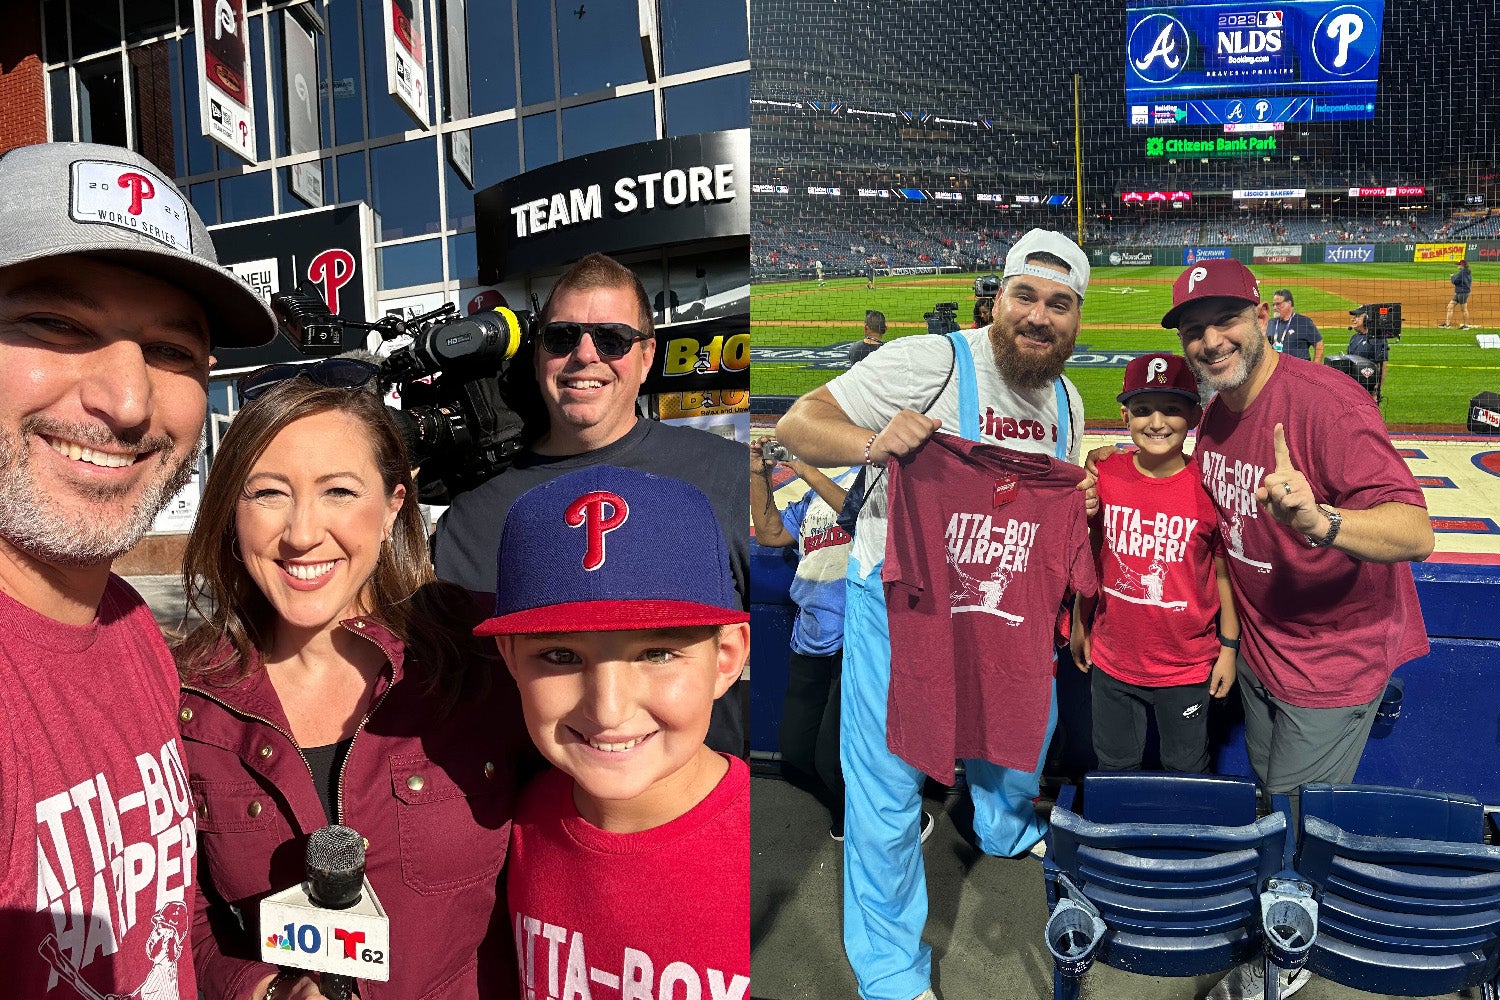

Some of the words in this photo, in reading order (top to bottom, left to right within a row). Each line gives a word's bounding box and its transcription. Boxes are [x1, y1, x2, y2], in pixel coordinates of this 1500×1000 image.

[1218, 14, 1256, 25] 2023
[1218, 30, 1282, 53] NLDS
[1327, 13, 1363, 67] P
[1229, 55, 1269, 64] Booking.com
[1315, 103, 1365, 113] Independence
[1166, 139, 1214, 151] Citizens
[1217, 138, 1247, 150] Bank
[1249, 136, 1276, 149] Park
[117, 172, 155, 216] P
[511, 183, 602, 238] TEAM
[614, 164, 736, 213] STORE
[98, 209, 137, 227] WORLD
[142, 221, 176, 245] SERIES
[1328, 247, 1371, 261] xfinity
[308, 249, 355, 315] P
[1189, 267, 1207, 293] P
[1147, 358, 1168, 383] P
[565, 491, 629, 571] P
[944, 512, 1040, 549] ATTA-BOY
[1104, 504, 1198, 542] ATTA-BOY
[947, 537, 1030, 572] HARPER!
[1106, 526, 1186, 562] HARPER!
[284, 923, 321, 954] 10
[362, 949, 384, 964] 62
